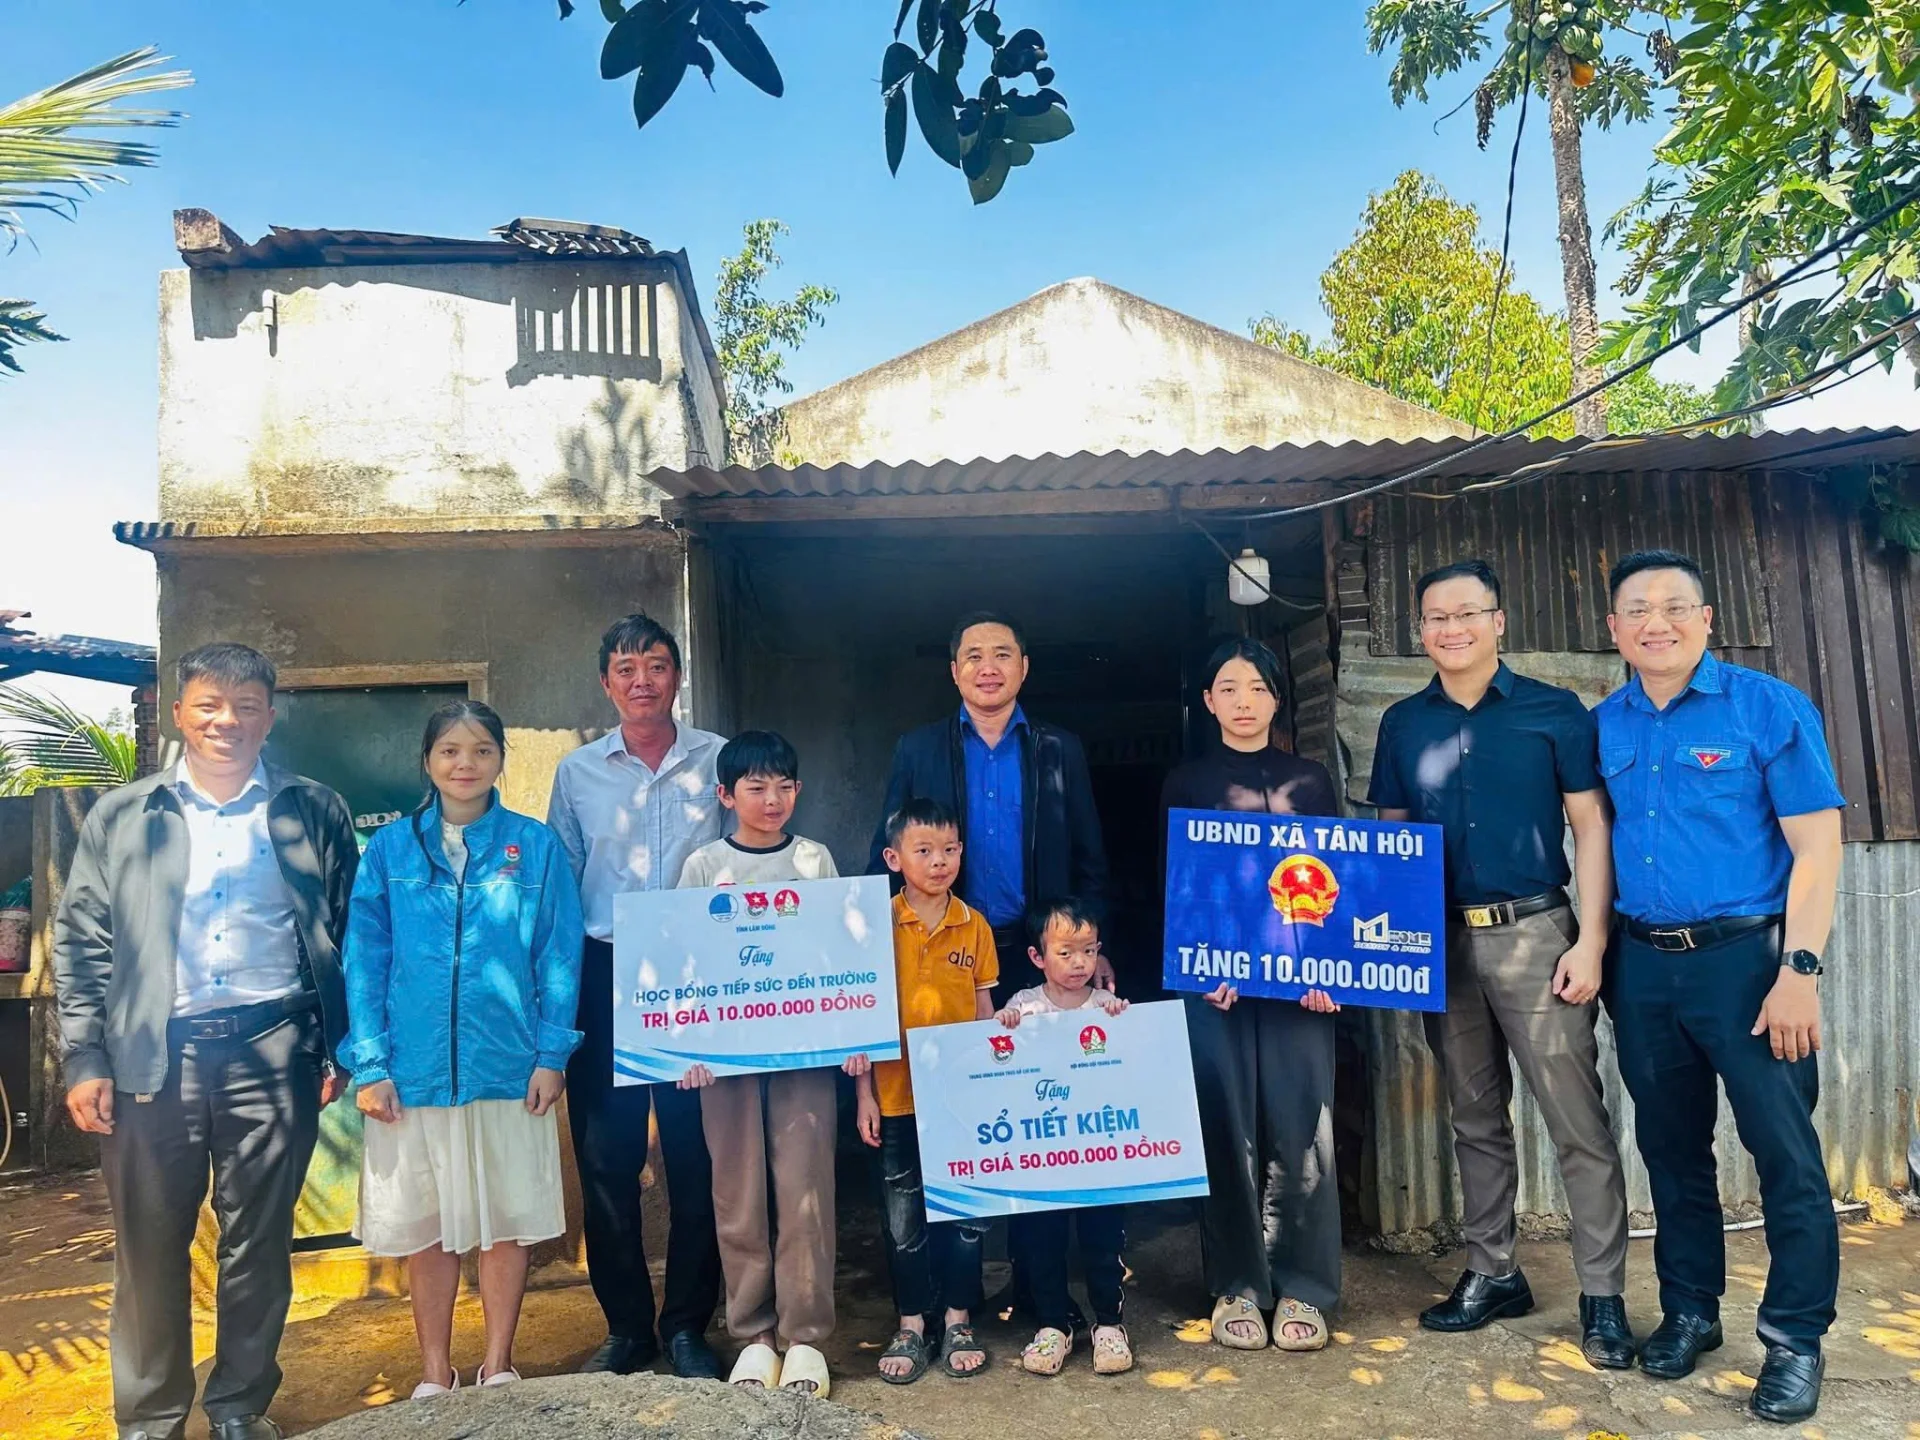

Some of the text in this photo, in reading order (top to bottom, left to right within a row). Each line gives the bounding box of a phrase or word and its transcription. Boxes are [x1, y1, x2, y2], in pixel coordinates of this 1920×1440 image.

[1188, 820, 1423, 860] UBND XÃ TÂN HỘI
[739, 945, 774, 966] Tặng
[1178, 943, 1430, 995] TẶNG 10.000.000đ
[635, 970, 877, 1005] HỌC BỔNG TIẾP SỨC ĐẾN TRƯỜNG
[642, 988, 876, 1032] TRỊ GIÁ 10.000.000 ĐỒNG
[1036, 1079, 1071, 1101] Tặng
[977, 1105, 1139, 1144] SỔ TIẾT KIỆM
[948, 1136, 1181, 1179] TRỊ GIÁ 50.000.000 ĐỒNG
